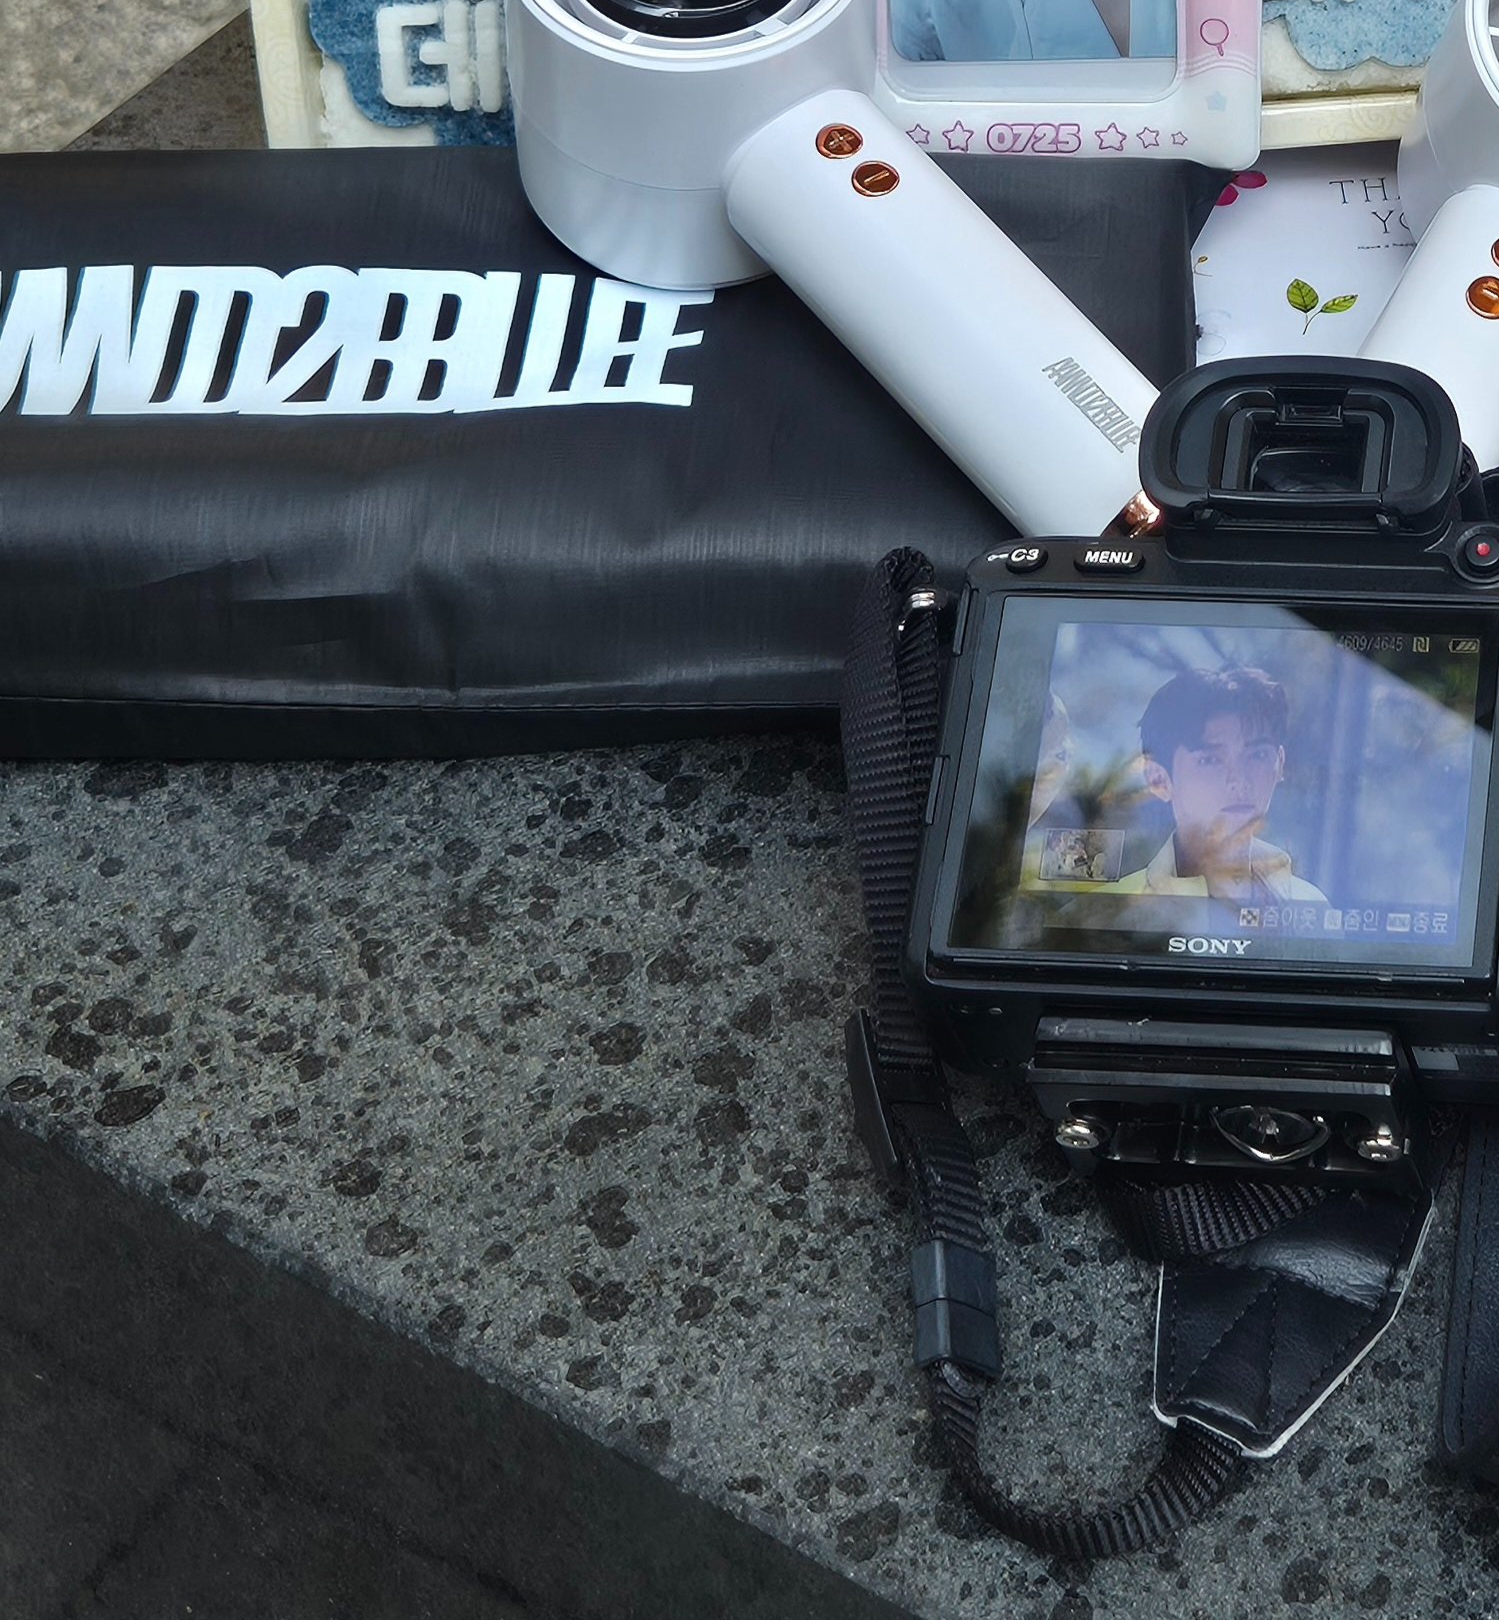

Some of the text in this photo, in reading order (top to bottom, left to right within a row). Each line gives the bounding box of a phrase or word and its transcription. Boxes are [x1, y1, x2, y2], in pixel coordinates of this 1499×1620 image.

[987, 123, 1082, 153] 0725
[1011, 547, 1040, 564] C3
[1084, 550, 1134, 566] MENU
[1168, 937, 1252, 956] SONY
